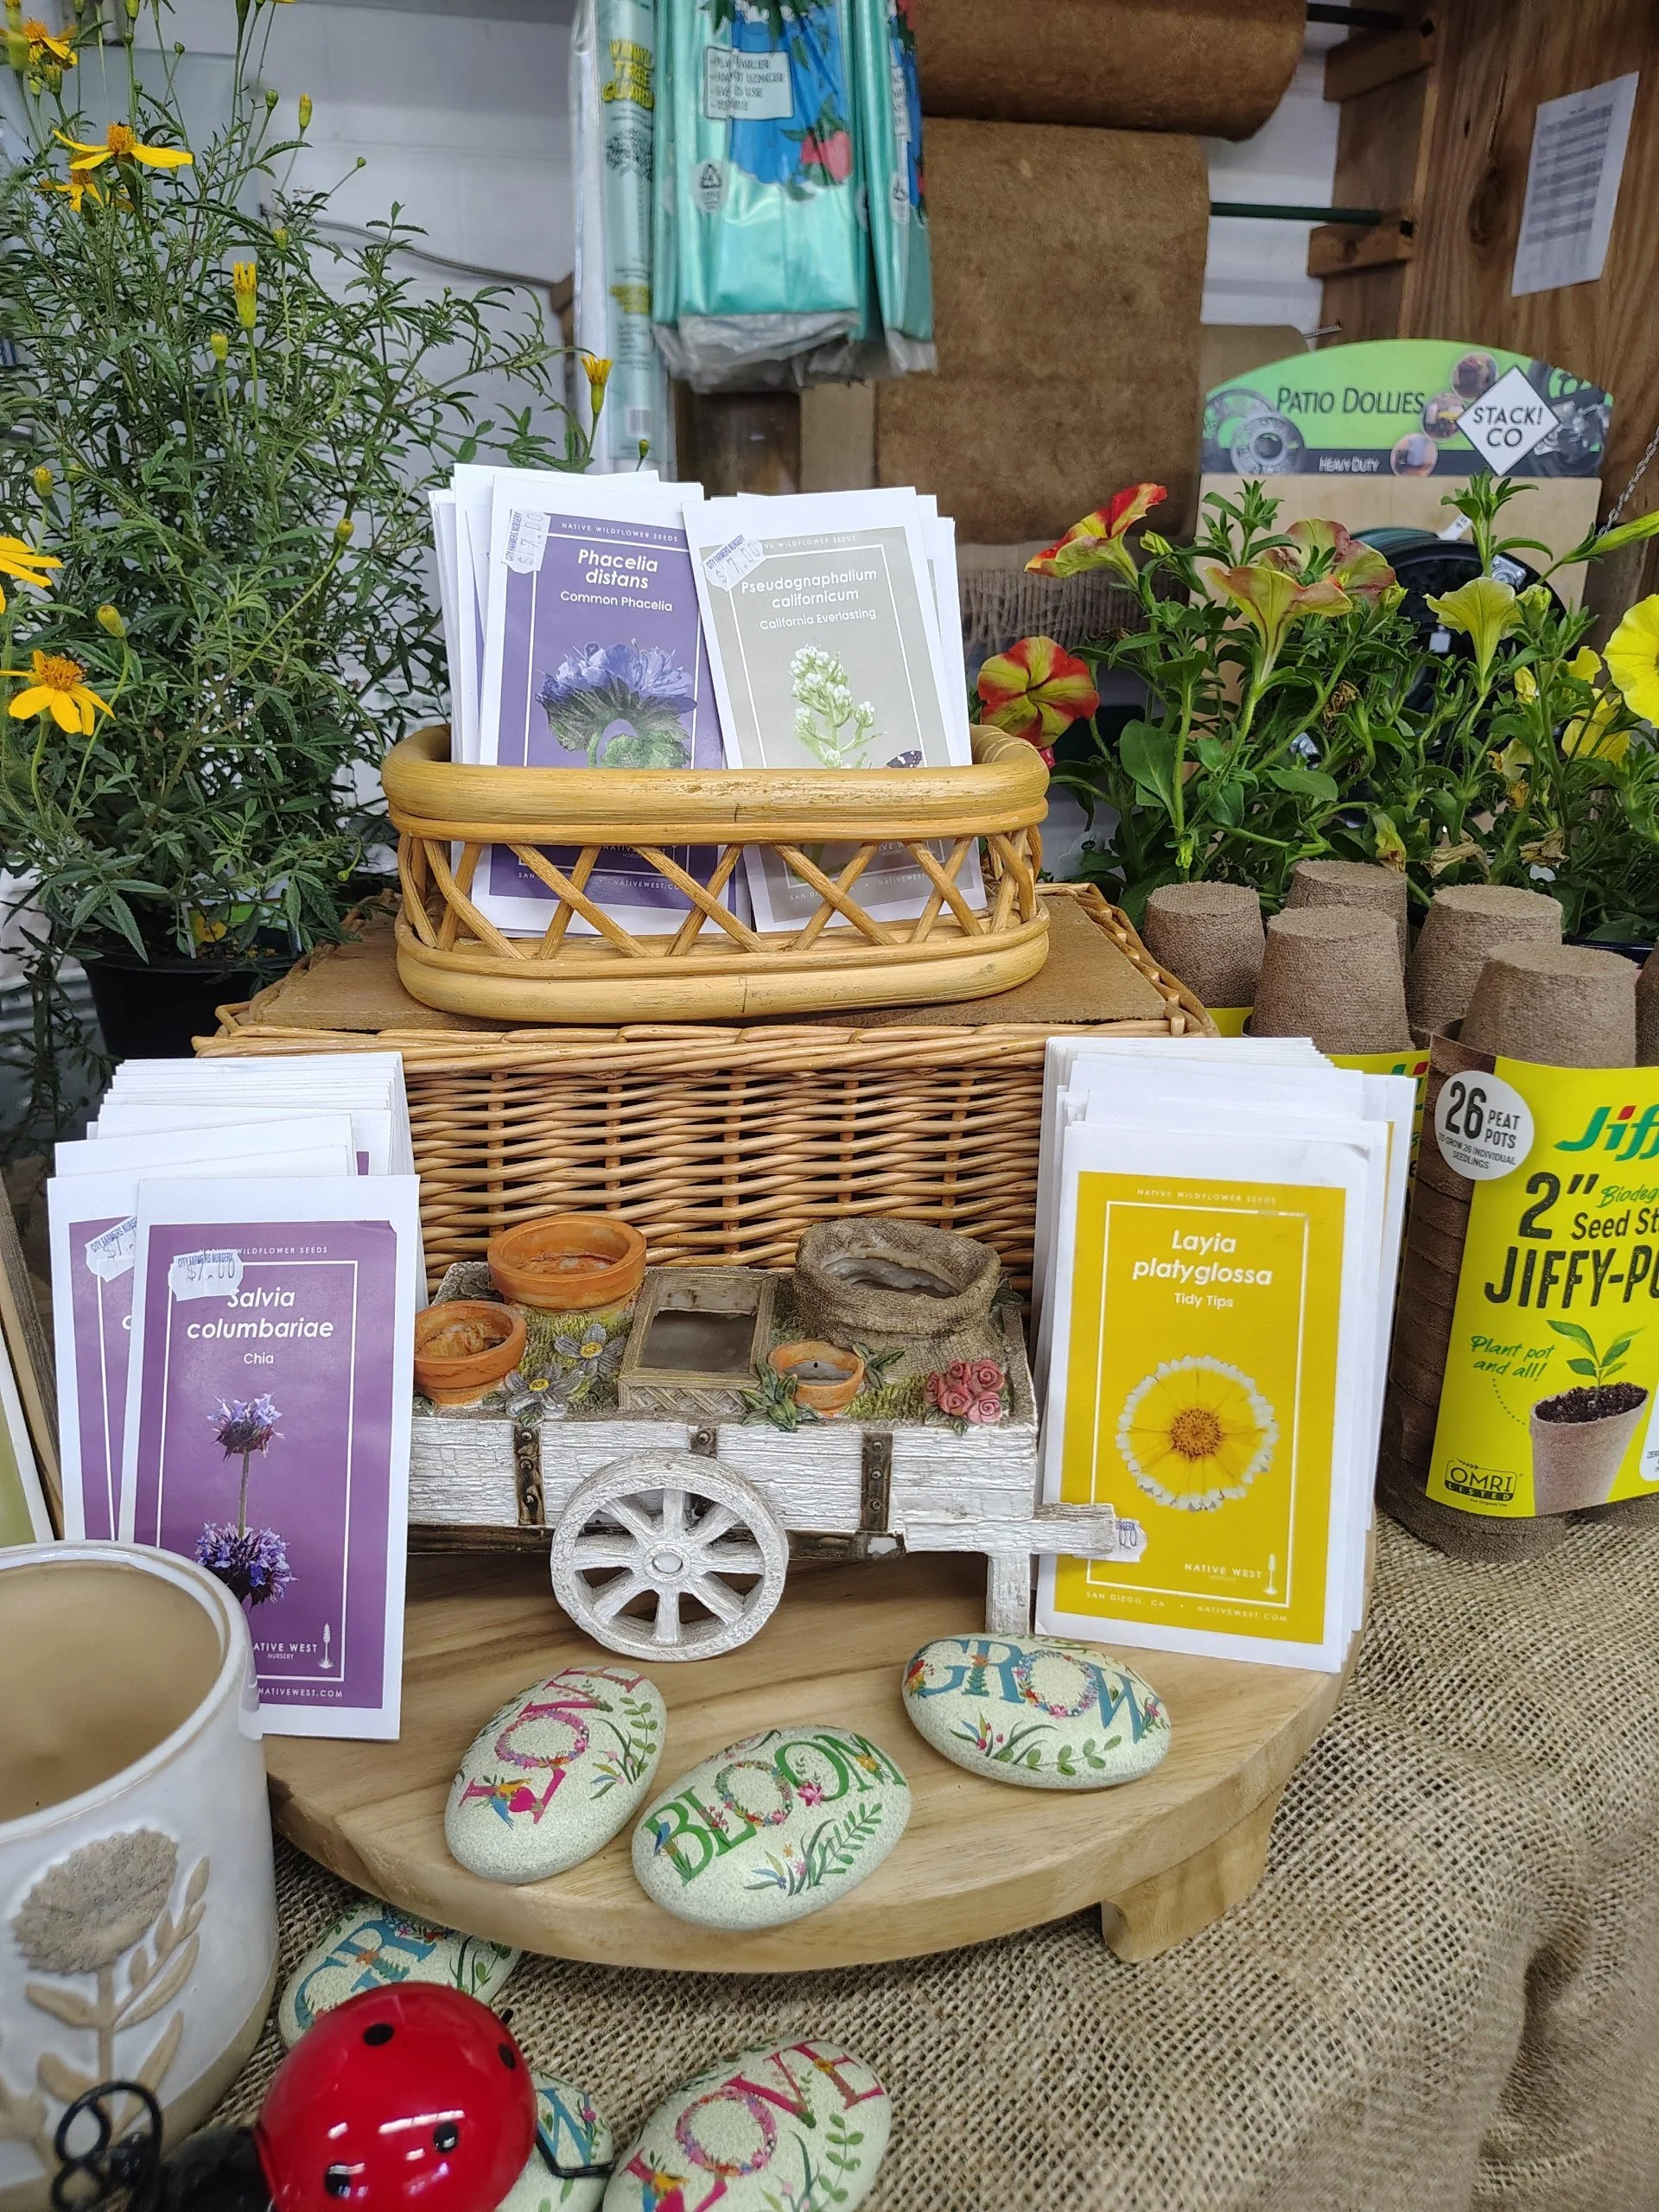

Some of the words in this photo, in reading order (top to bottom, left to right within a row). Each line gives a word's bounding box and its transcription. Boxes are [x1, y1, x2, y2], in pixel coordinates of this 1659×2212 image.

[1277, 387, 1335, 413] PATIO
[1343, 387, 1425, 415] DOLLIES
[1473, 406, 1542, 424] STACK!
[1486, 429, 1522, 447] CO
[562, 521, 592, 532] NATIVE
[595, 526, 649, 538] WILDFLOWER
[652, 533, 678, 543] SEEDS
[778, 537, 830, 549] WILDFLOWER
[577, 549, 658, 573] Phacelia
[585, 569, 649, 589] distans
[741, 569, 877, 596] Pseudognaphalium
[560, 590, 618, 607] Common
[620, 596, 673, 612] Phacelia
[772, 588, 859, 608] californicum
[760, 614, 814, 630] California
[817, 608, 877, 624] Everlasting
[613, 880, 679, 891] NATIVEWEST.CO
[1445, 1080, 1486, 1140] 26
[1487, 1109, 1521, 1130] PEAT
[1438, 1132, 1445, 1141] TO
[1446, 1135, 1463, 1151] GROW
[1463, 1145, 1471, 1154] 26
[1472, 1147, 1516, 1166] INDIVIDUAL
[1484, 1128, 1516, 1149] POTS
[1452, 1150, 1490, 1170] SEEDLINGS
[1137, 1189, 1172, 1198] NATIVE
[1177, 1192, 1242, 1203] WILDFLOWER
[1246, 1196, 1276, 1205] SEEDS
[1569, 1209, 1631, 1241] Seed
[236, 1246, 296, 1255] WILDFLOWER
[299, 1246, 328, 1255] SEEDS
[1171, 1229, 1237, 1255] Layia
[1132, 1257, 1273, 1286] platyglossa
[1174, 1293, 1203, 1308] Tidy
[1206, 1294, 1234, 1309] Tips
[187, 1317, 334, 1339] columbariae
[243, 1351, 274, 1364] Chia
[1470, 1335, 1522, 1358] Plant
[1523, 1344, 1555, 1362] pot
[1472, 1359, 1509, 1376] and
[1512, 1362, 1548, 1382] all!
[1450, 1466, 1513, 1492] OMRI
[1447, 1482, 1510, 1500] LISTED
[1185, 1562, 1226, 1574] NATIVE
[1232, 1567, 1262, 1580] WEST
[1086, 1591, 1105, 1600] SAN
[1151, 1599, 1166, 1608] CA
[1197, 1605, 1287, 1622] NATIVEWEST.COM
[253, 1642, 284, 1652] ATIVE
[289, 1643, 318, 1654] WEST
[258, 1688, 343, 1698] NATIVEWEST.COM
[907, 1638, 1162, 1745] GROW
[459, 1666, 645, 1825] LOVE
[641, 1732, 907, 1887] BLOOM
